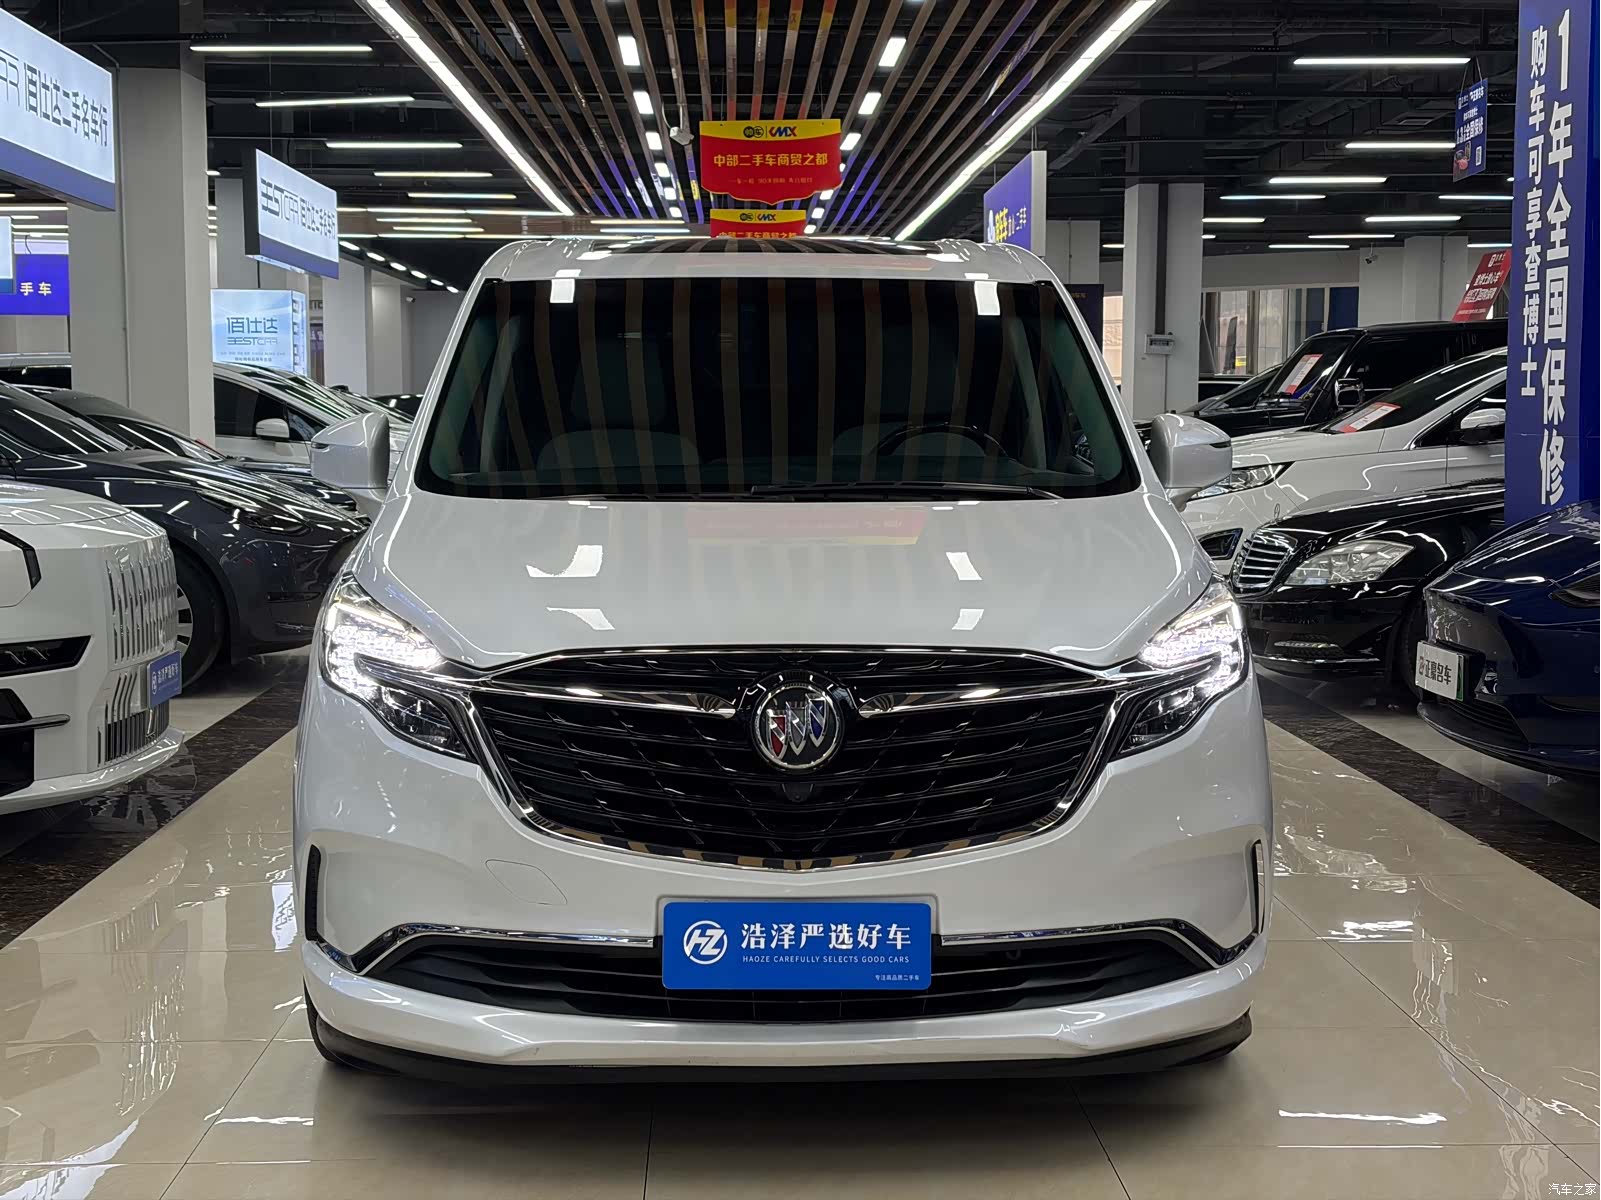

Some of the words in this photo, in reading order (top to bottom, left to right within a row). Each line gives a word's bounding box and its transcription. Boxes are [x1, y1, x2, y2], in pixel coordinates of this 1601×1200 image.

[24, 62, 108, 147] 佰仕达二手名车行
[713, 153, 828, 167] 中部二手车商贸之都
[299, 197, 335, 239] 佰仕达二手名车行
[1521, 25, 1548, 397] 购车可享查博士
[1540, 9, 1573, 506] 1年全国保修
[226, 316, 278, 334] 佰仕达
[741, 923, 911, 950] 浩泽严选好车
[742, 955, 771, 964] HAOZE
[773, 955, 820, 964] CAREFULLY
[823, 955, 859, 964] SELECTS
[861, 955, 886, 964] GOOD
[888, 955, 910, 964] CARS
